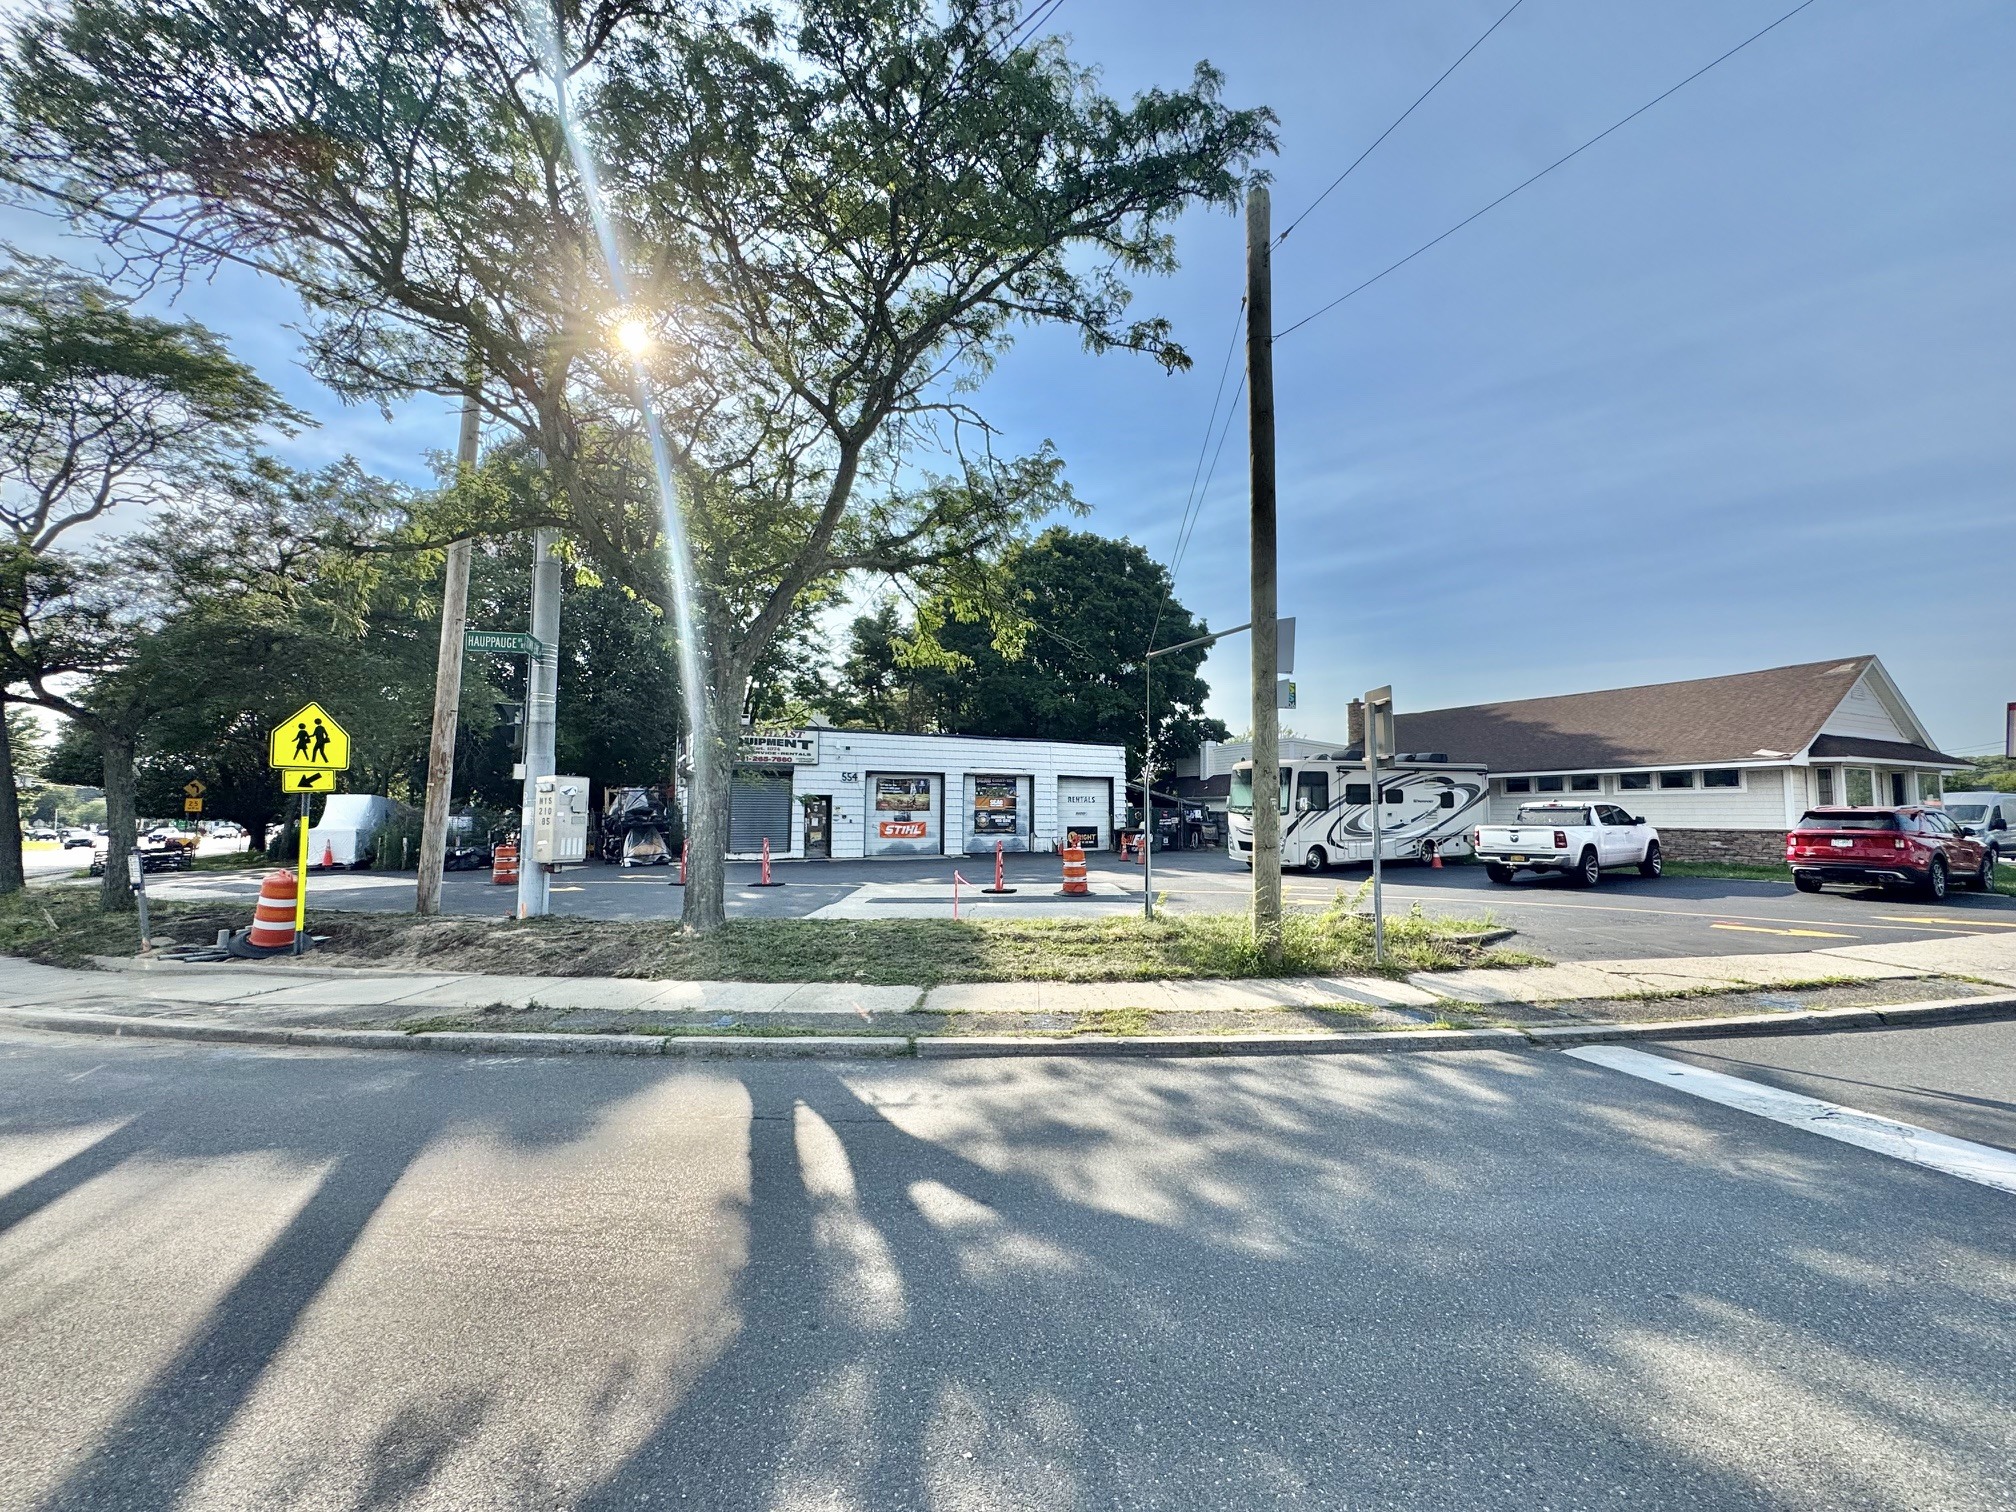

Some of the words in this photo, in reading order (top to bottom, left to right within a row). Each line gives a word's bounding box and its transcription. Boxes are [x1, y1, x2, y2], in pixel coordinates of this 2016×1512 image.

[468, 635, 517, 648] HAUPPAUGE
[842, 772, 858, 781] 554
[1067, 796, 1096, 804] RENTALS
[538, 807, 552, 815] 210
[884, 825, 922, 835] STIHL
